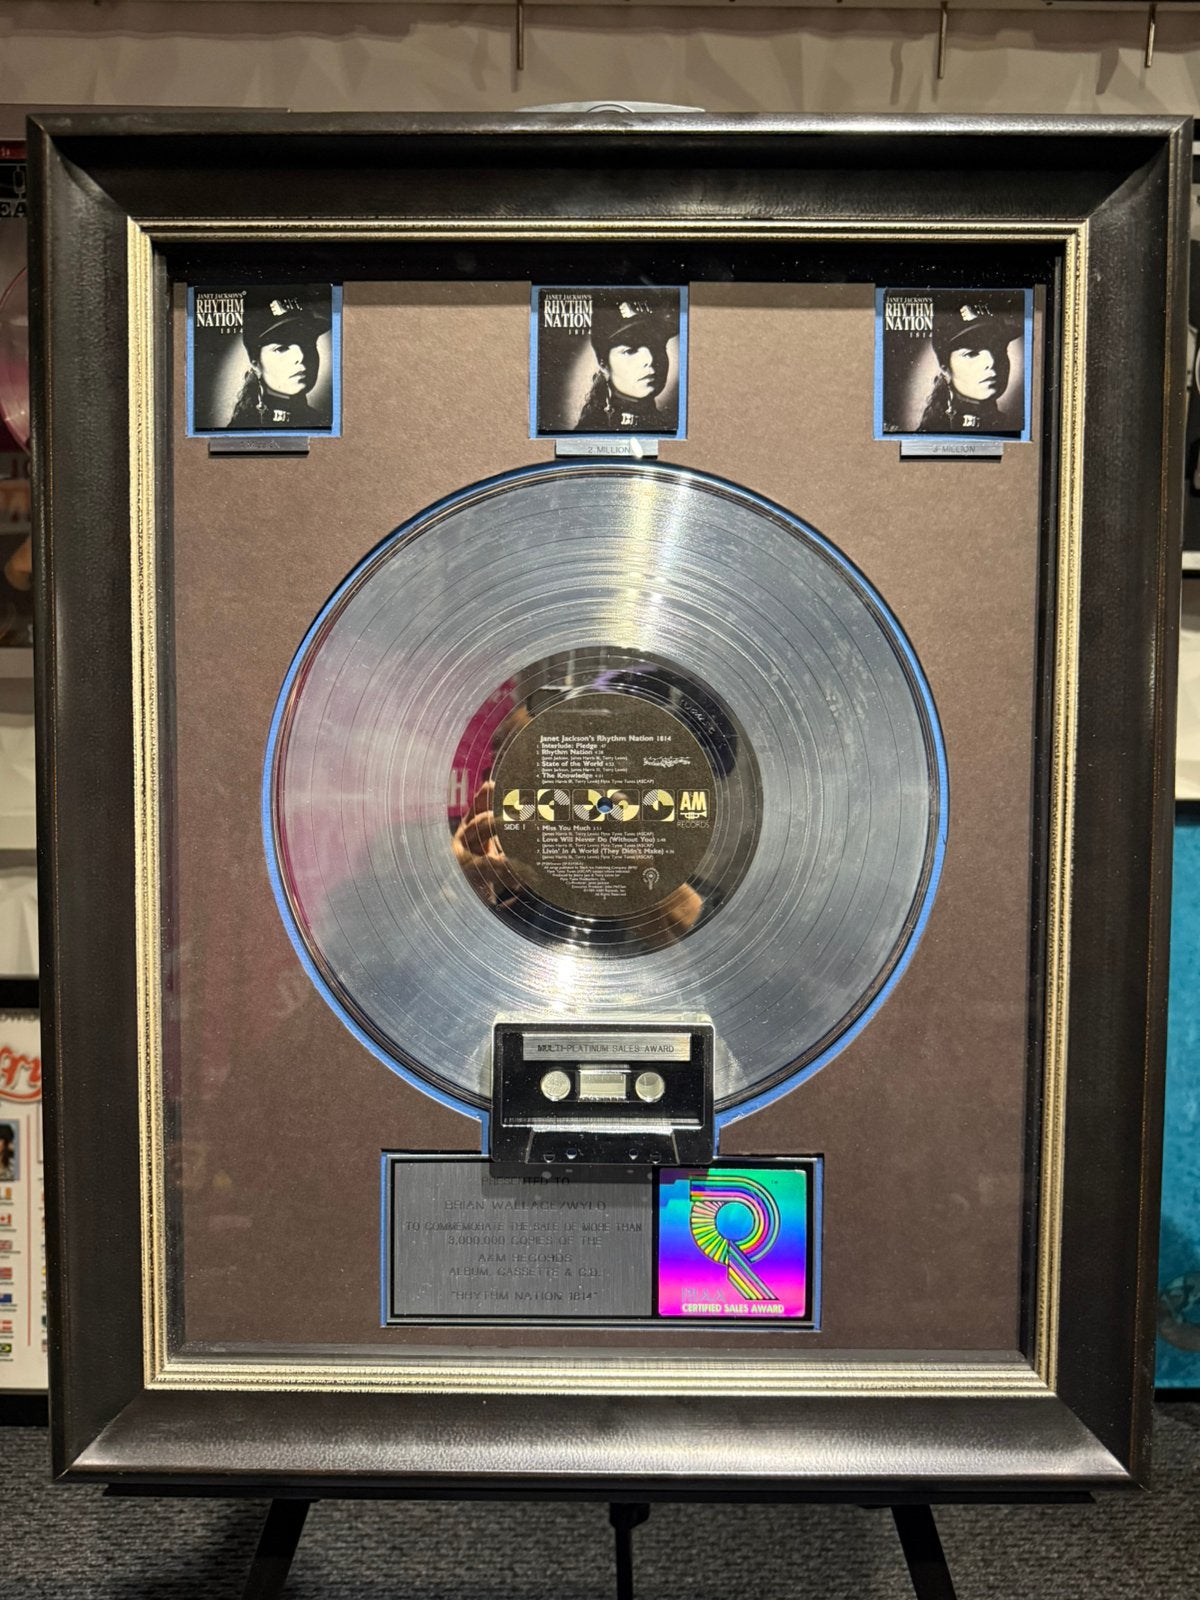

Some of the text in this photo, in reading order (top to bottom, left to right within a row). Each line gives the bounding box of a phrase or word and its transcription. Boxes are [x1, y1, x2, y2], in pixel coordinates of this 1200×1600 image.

[196, 299, 244, 313] RHYTHM
[544, 300, 592, 314] RHYTHM
[885, 303, 934, 316] RHYTHM
[196, 312, 244, 327] NATION
[544, 313, 592, 328] NATION
[886, 316, 933, 330] NATION
[540, 735, 559, 743] Janet
[561, 734, 594, 743] Jackson's
[596, 734, 626, 743] Rhythm
[677, 820, 710, 829] RECORDS
[538, 1044, 674, 1053] MULTI-PLATINUM SALES AWARD
[556, 1176, 570, 1186] TO
[444, 1200, 485, 1210] BRIAN
[406, 1222, 642, 1232] TO COMMEMORATE THE SALE OF MORE THAN
[510, 1235, 552, 1246] COPIES
[558, 1236, 574, 1246] OF
[582, 1236, 602, 1246] THE
[512, 1253, 573, 1262] RECORDS
[497, 1267, 559, 1276] CASSETTE
[514, 1291, 562, 1300] NATION
[682, 1303, 784, 1314] CERTIFIED SALES AWARD
